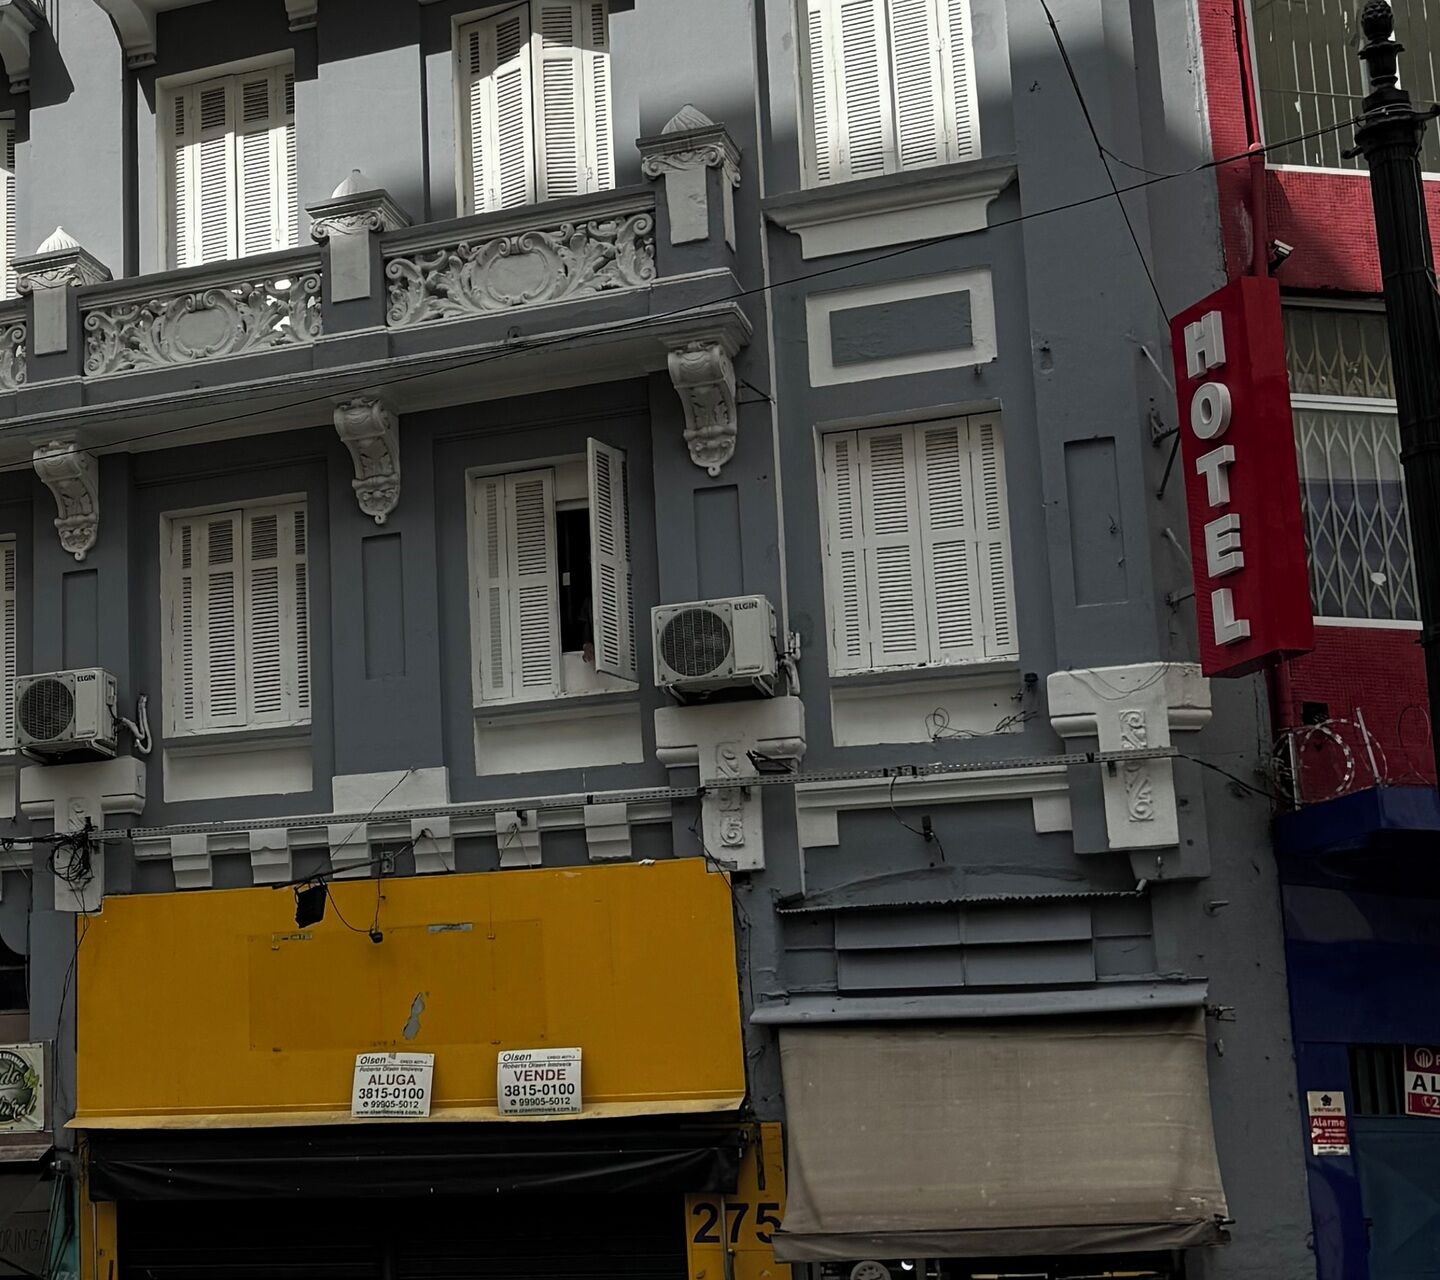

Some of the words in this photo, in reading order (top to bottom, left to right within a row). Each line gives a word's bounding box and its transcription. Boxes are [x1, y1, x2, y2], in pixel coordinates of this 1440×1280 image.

[1183, 310, 1251, 646] HOTEL
[734, 602, 758, 610] ELGIN
[76, 674, 96, 682] ELGIN
[368, 1074, 416, 1085] ALUGA
[514, 1068, 566, 1082] VENDE
[359, 1088, 424, 1099] 3815-0100
[504, 1083, 575, 1097] 3815-0100
[519, 1097, 571, 1106] 99905-5012
[1312, 1118, 1345, 1128] Alarme
[693, 1202, 782, 1244] 275
